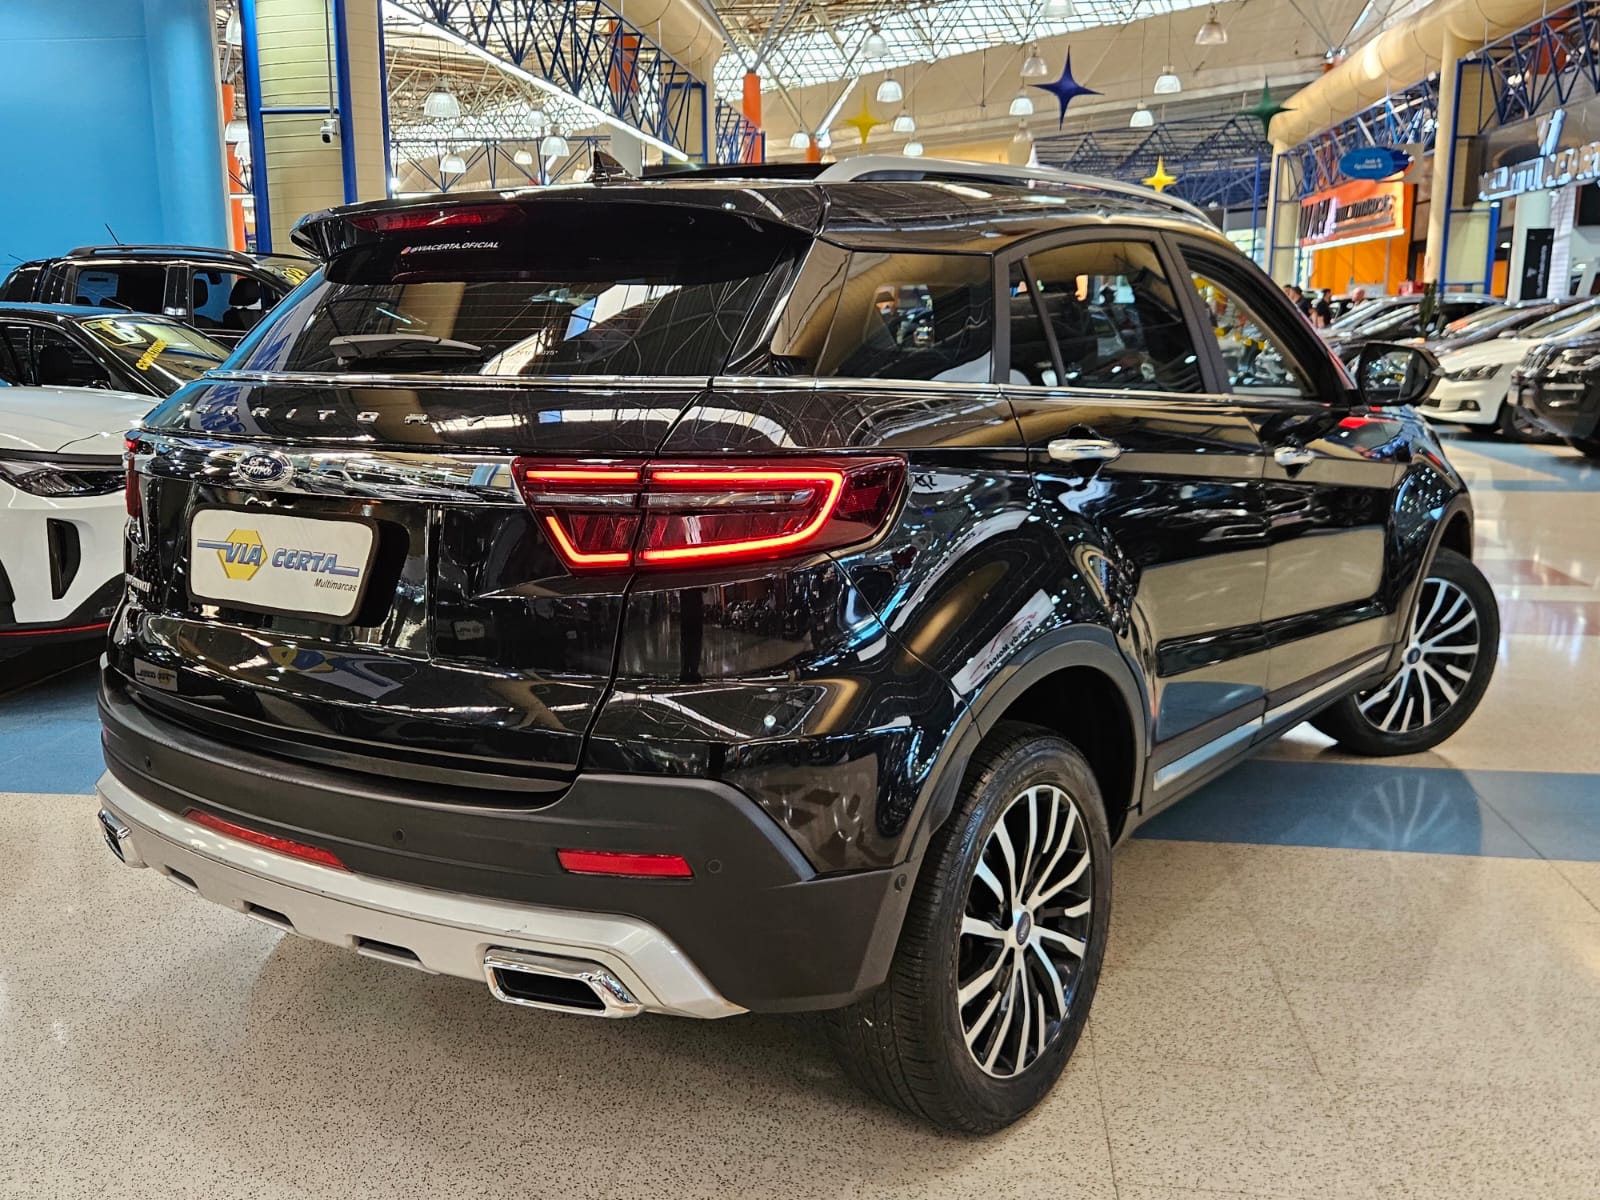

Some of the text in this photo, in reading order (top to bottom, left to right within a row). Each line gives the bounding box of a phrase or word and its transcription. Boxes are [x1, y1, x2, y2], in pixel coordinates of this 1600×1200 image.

[225, 543, 338, 573] VIA CERTA
[314, 577, 358, 592] Multimarcas
